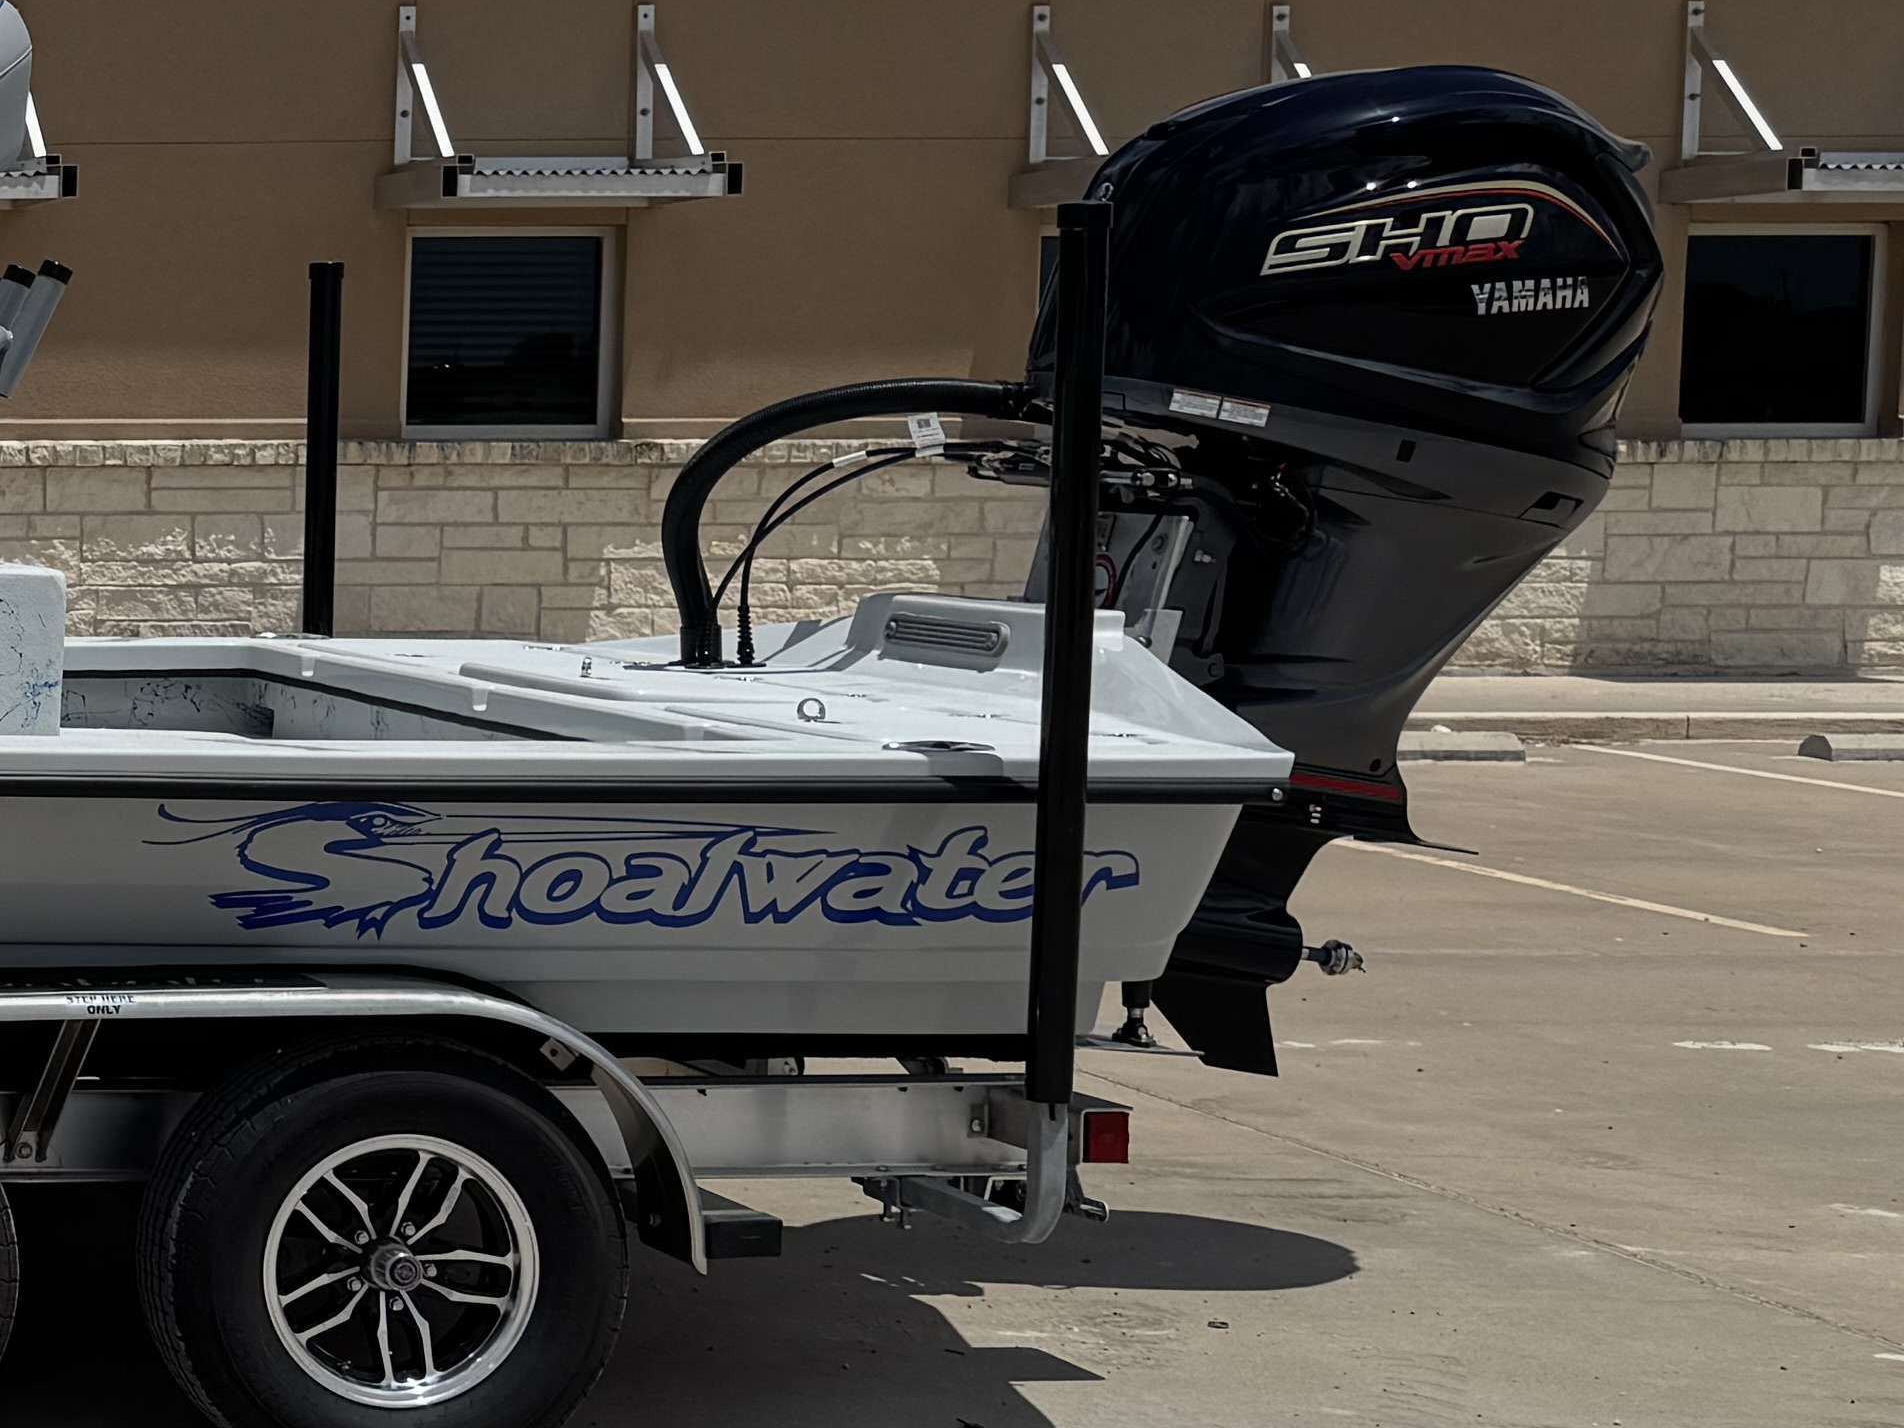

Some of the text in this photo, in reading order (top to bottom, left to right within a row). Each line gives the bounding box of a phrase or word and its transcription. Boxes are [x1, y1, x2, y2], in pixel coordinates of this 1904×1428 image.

[1261, 203, 1534, 276] SHO
[1470, 275, 1591, 316] YAMAHA
[87, 1005, 121, 1015] ONLY
